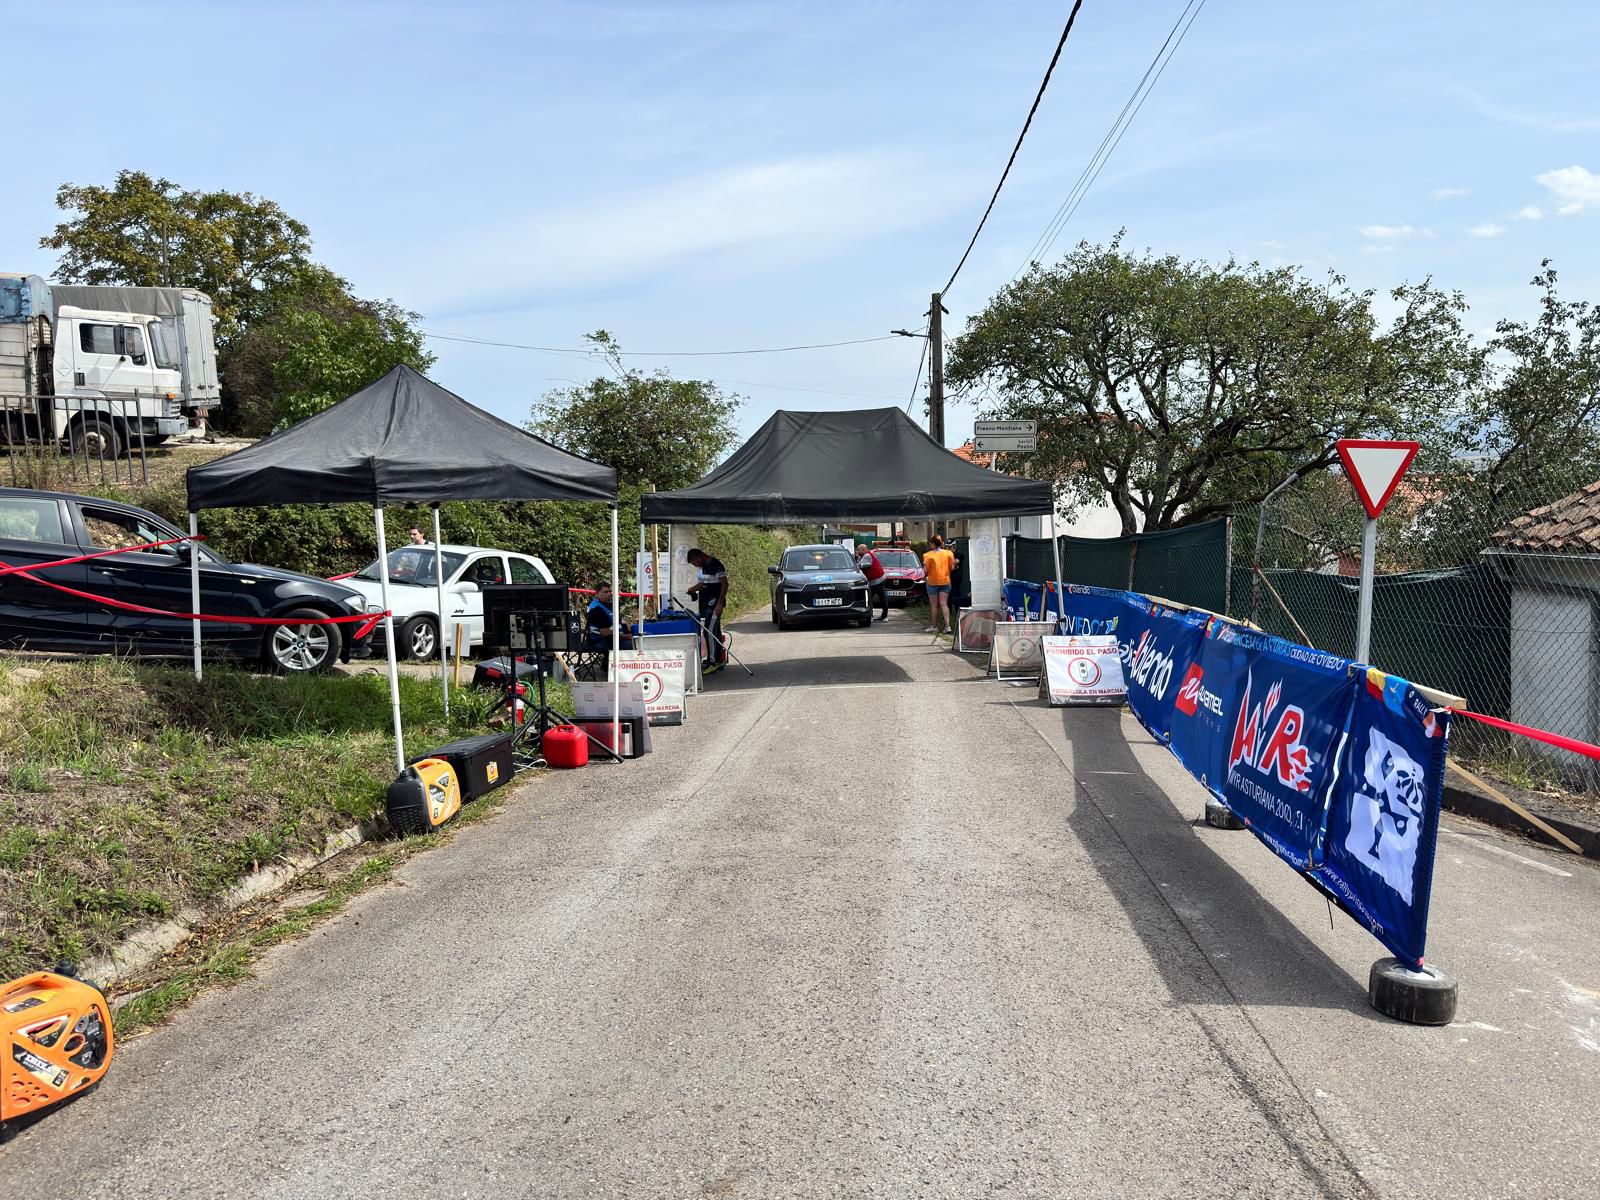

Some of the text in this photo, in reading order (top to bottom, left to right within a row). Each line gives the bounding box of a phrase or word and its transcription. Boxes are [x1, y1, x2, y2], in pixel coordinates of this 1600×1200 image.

[1308, 652, 1316, 664] DE
[1316, 653, 1345, 671] OVIEDO
[1413, 698, 1429, 716] RALLY
[1240, 775, 1275, 814] ASTURIANA
